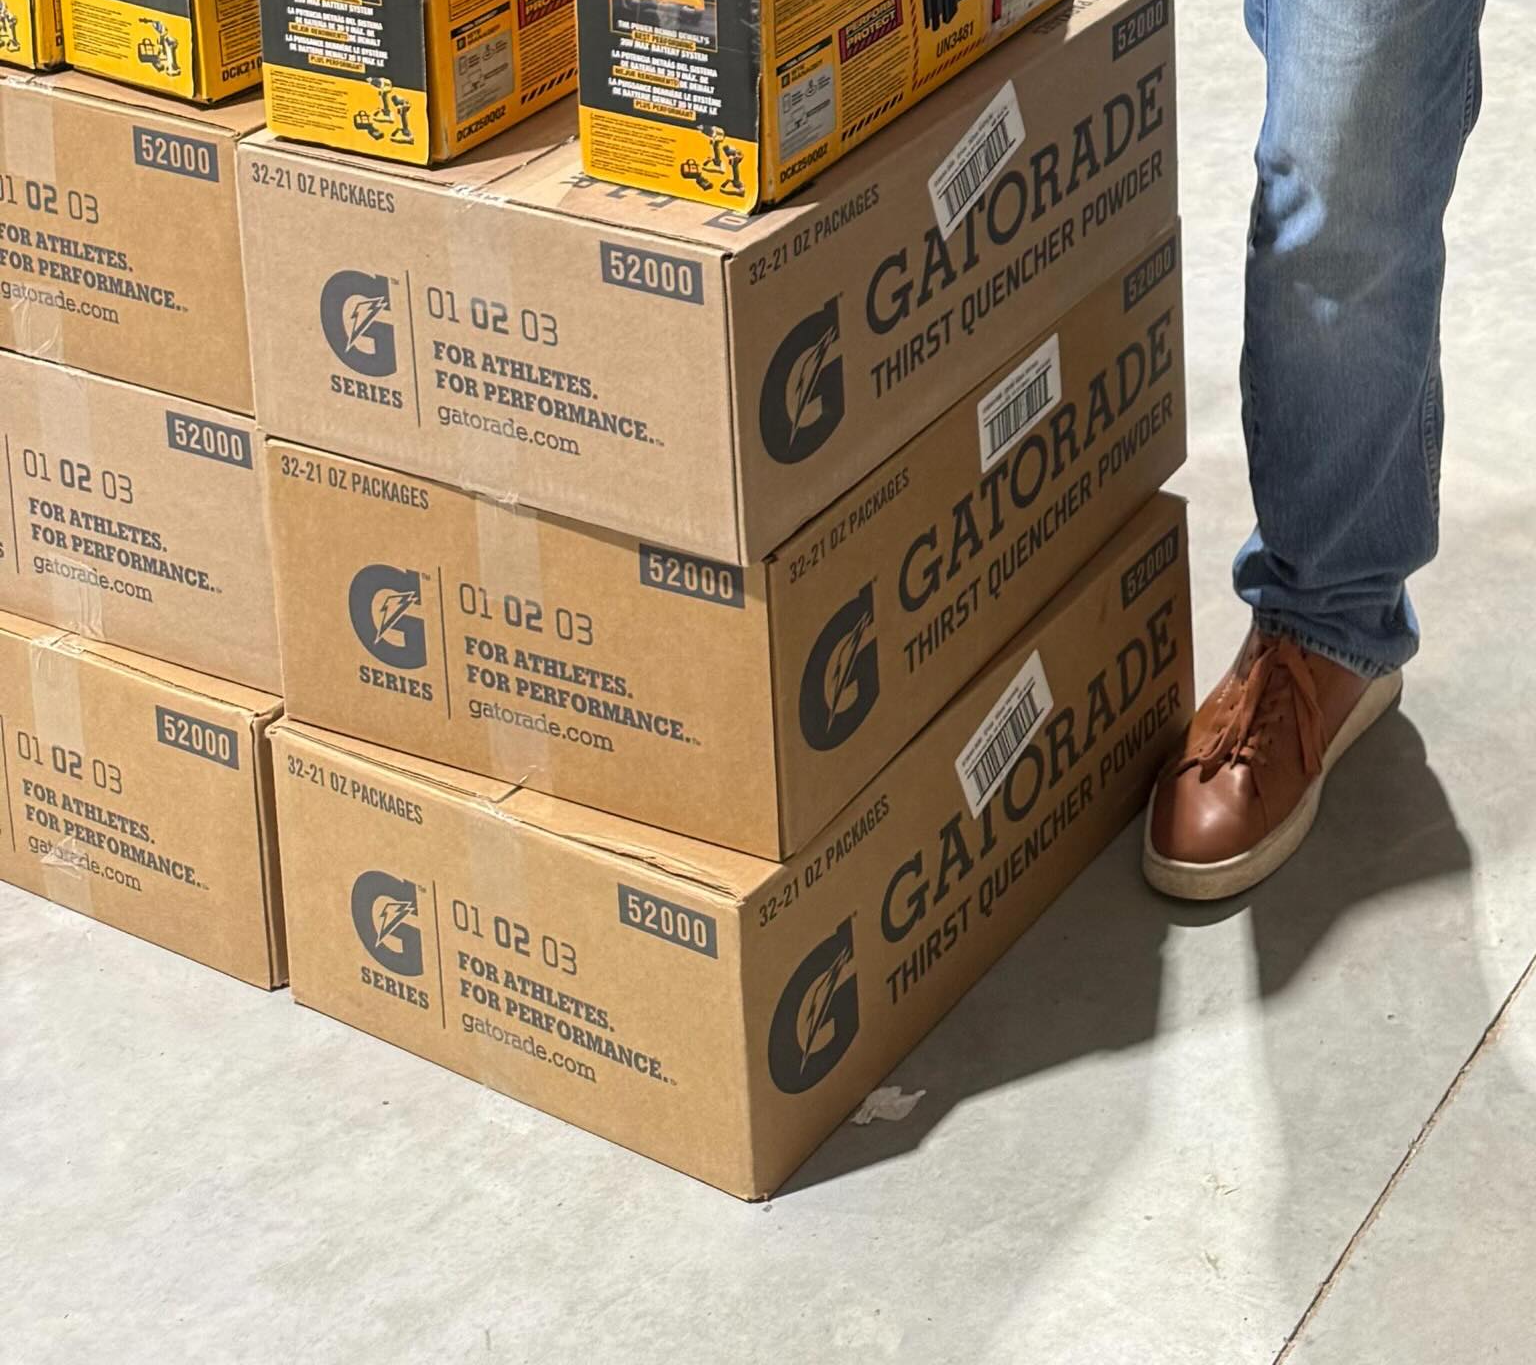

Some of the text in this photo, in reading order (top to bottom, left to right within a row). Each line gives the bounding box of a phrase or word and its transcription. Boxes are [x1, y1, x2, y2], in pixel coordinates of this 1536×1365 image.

[846, 9, 898, 49] PROTECT
[936, 21, 975, 59] UN3481
[141, 134, 210, 174] 52000
[26, 180, 58, 215] 02
[68, 190, 99, 225] 03
[252, 162, 396, 214] 32-21 OZ PACKAGES
[1082, 152, 1163, 238] POWDER
[36, 231, 134, 273] ATHLETES.
[748, 241, 788, 286] 32-21
[792, 227, 812, 258] OZ
[815, 183, 881, 245] PACKAGES
[0, 247, 182, 312] FOR PERFORMANCE.
[1, 281, 120, 325] gatorade.com
[609, 250, 693, 297] 52000
[961, 222, 1075, 337] QUENCHER
[1127, 245, 1173, 303] 52000
[320, 269, 398, 378] G
[427, 286, 559, 347] 01 02 03
[433, 340, 599, 400] FOR ATHLETES.
[759, 294, 845, 465] G
[870, 307, 954, 399] THIRST
[330, 373, 404, 410] SERIES
[435, 369, 655, 445] FOR PERFORMANCE.
[174, 419, 243, 462] 52000
[437, 405, 581, 456] gatorade.com
[899, 310, 1173, 613] GATORADE
[1098, 392, 1173, 489] POWDER
[23, 449, 133, 505] 01 02 03
[281, 455, 429, 510] 32-21 OZ PACKAGES
[28, 497, 168, 552] FOR ATHLETES.
[31, 523, 215, 592] FOR PERFORMANCE.
[788, 468, 910, 584] 32-21 OZ PACKAGES
[988, 471, 1092, 602] QUENCHER
[33, 555, 153, 603] gatorade.com
[649, 554, 734, 600] 52000
[1126, 535, 1176, 603] 52000
[348, 564, 427, 670] G
[459, 583, 593, 646] 01 02 03
[903, 577, 981, 675] THIRST
[359, 665, 433, 702] SERIES
[464, 635, 634, 699] FOR ATHLETES.
[800, 579, 880, 753] G
[466, 664, 692, 743] FOR PERFORMANCE.
[468, 699, 615, 753] gatorade.com
[1100, 682, 1180, 789] POWDER
[17, 731, 123, 795] 01 02 03
[164, 715, 231, 761] 52000
[22, 778, 156, 845] FOR ATHLETES.
[287, 754, 423, 826] 32-21 OZ PACKAGES
[25, 804, 202, 888] FOR PERFORMANCE.
[758, 795, 890, 928] 32-21 OZ PACKAGES
[977, 773, 1094, 918] QUENCHER
[351, 870, 424, 977] G
[452, 899, 578, 977] 01 02 03
[628, 894, 708, 949] 52000
[361, 965, 430, 1010] SERIES
[457, 950, 616, 1033] FOR ATHLETES.
[885, 909, 974, 1007] THIRST
[460, 977, 670, 1084] FOR PERFORMANCE.
[767, 916, 860, 1095] G
[462, 1013, 598, 1084] gatorade.com
